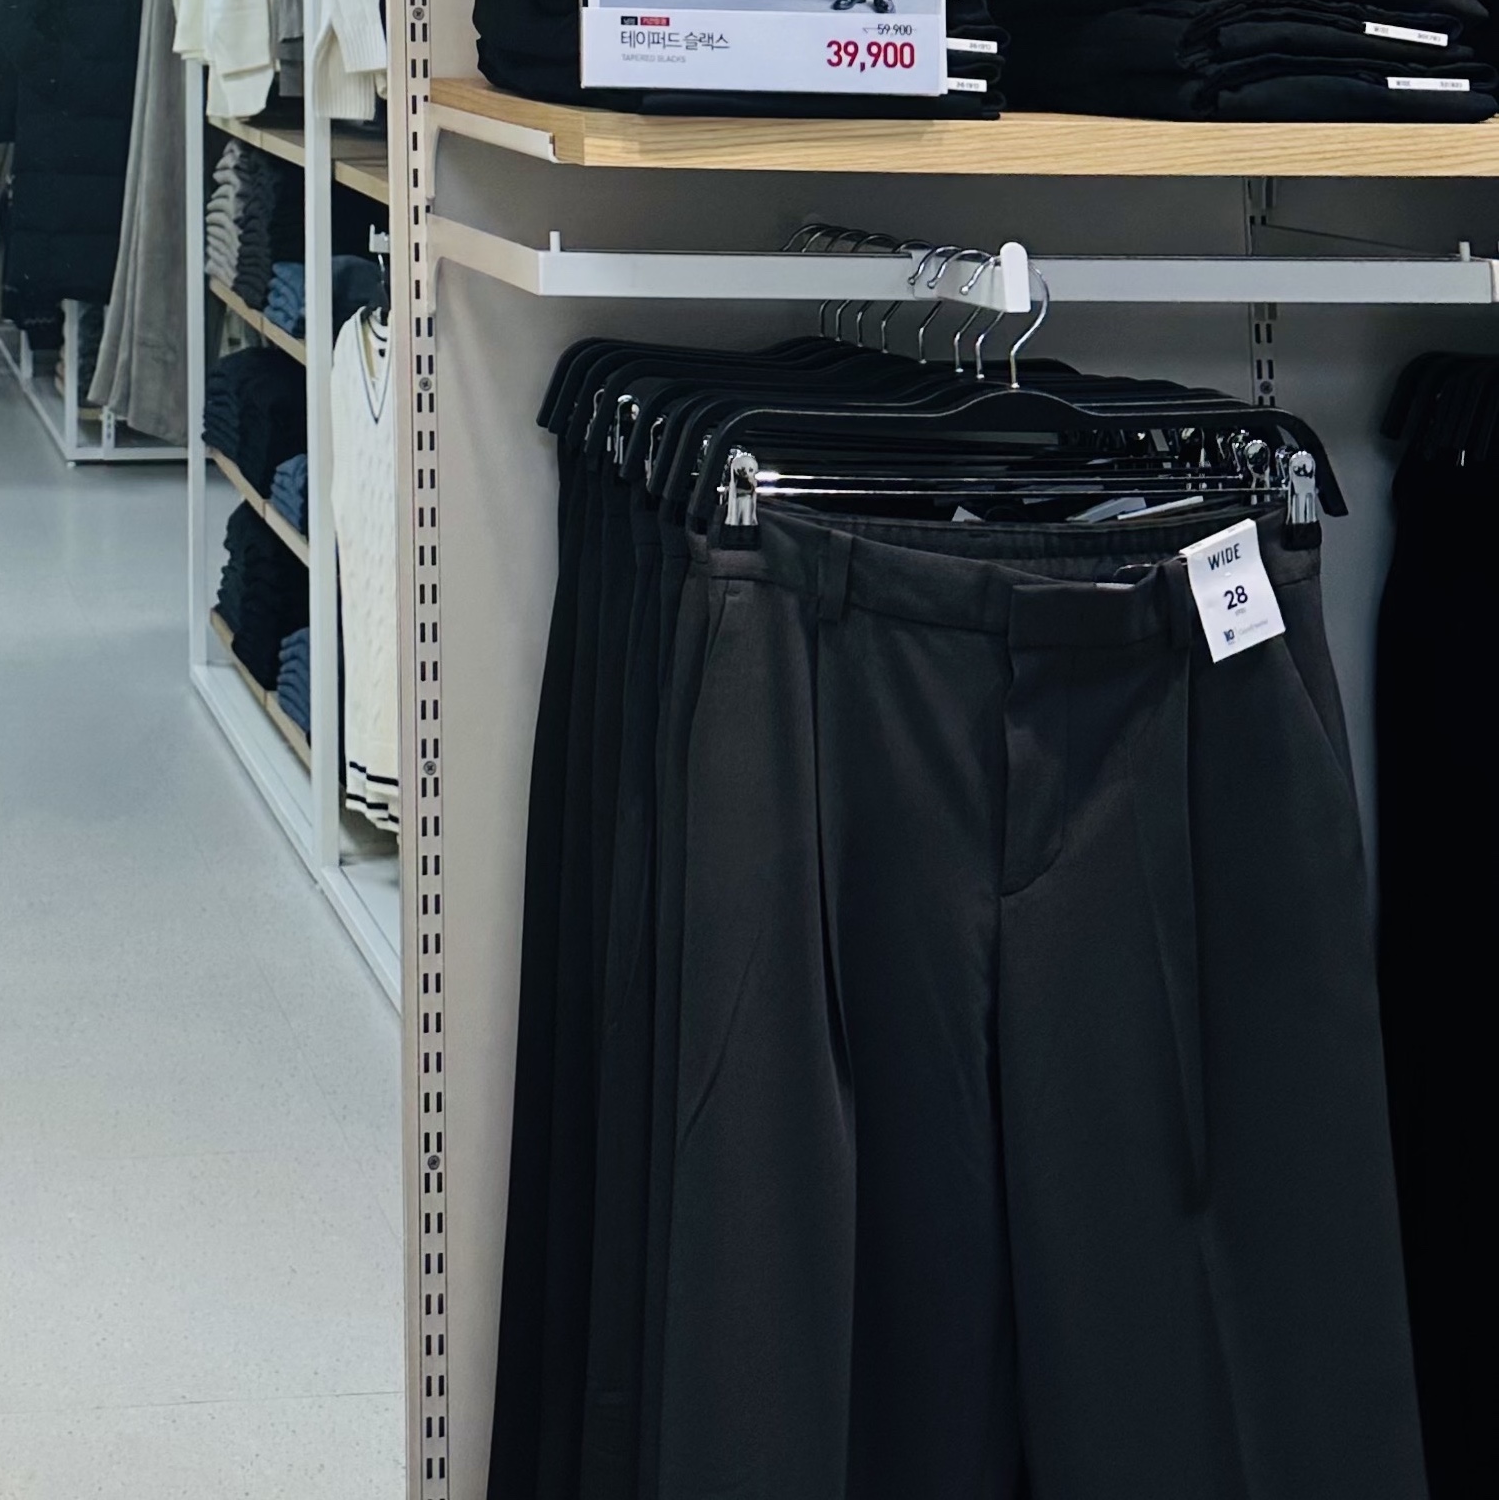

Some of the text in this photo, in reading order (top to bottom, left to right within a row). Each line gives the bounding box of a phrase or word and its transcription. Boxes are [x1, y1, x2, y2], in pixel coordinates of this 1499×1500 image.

[620, 30, 731, 51] 테이퍼드 슬랙스
[826, 39, 915, 73] 39,900
[1207, 542, 1241, 570] WIDE
[1223, 585, 1249, 610] 28
